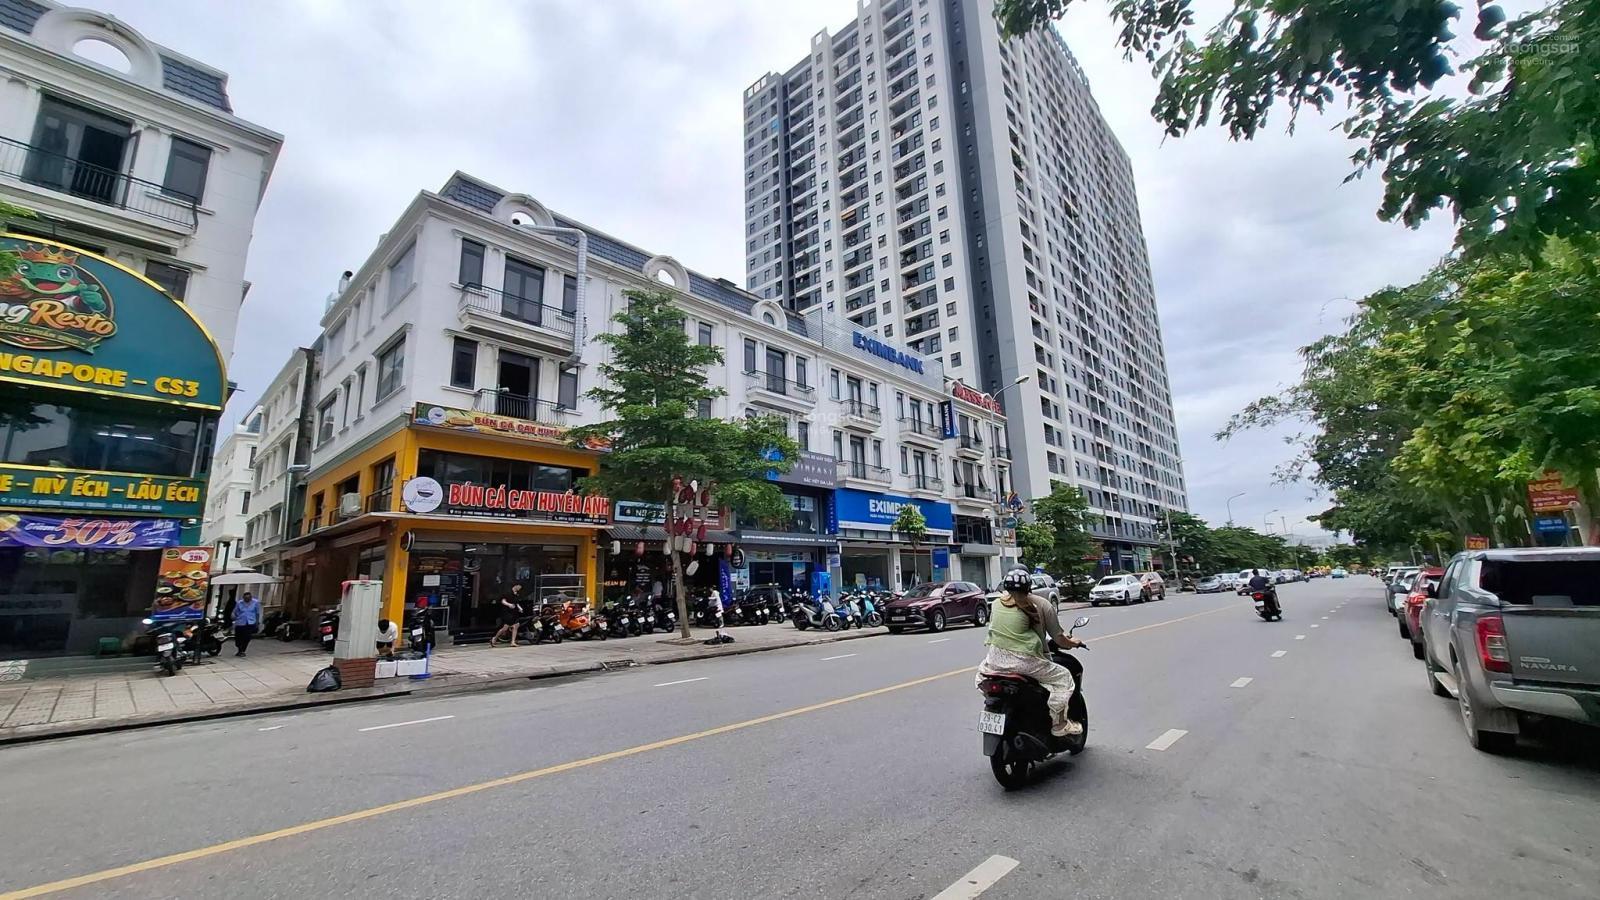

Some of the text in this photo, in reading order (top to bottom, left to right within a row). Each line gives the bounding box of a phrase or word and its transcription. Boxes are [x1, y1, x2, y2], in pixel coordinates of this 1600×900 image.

[852, 331, 924, 375] EXIMBANK
[154, 376, 200, 398] CS3
[71, 474, 109, 497] ẾCH
[126, 477, 163, 500] LẨU
[165, 480, 200, 502] ẾCH
[449, 481, 484, 506] BÚN
[485, 484, 506, 509] CÁ
[508, 489, 537, 511] CAY
[43, 518, 141, 546] 50%
[1520, 662, 1578, 672] NAVARA
